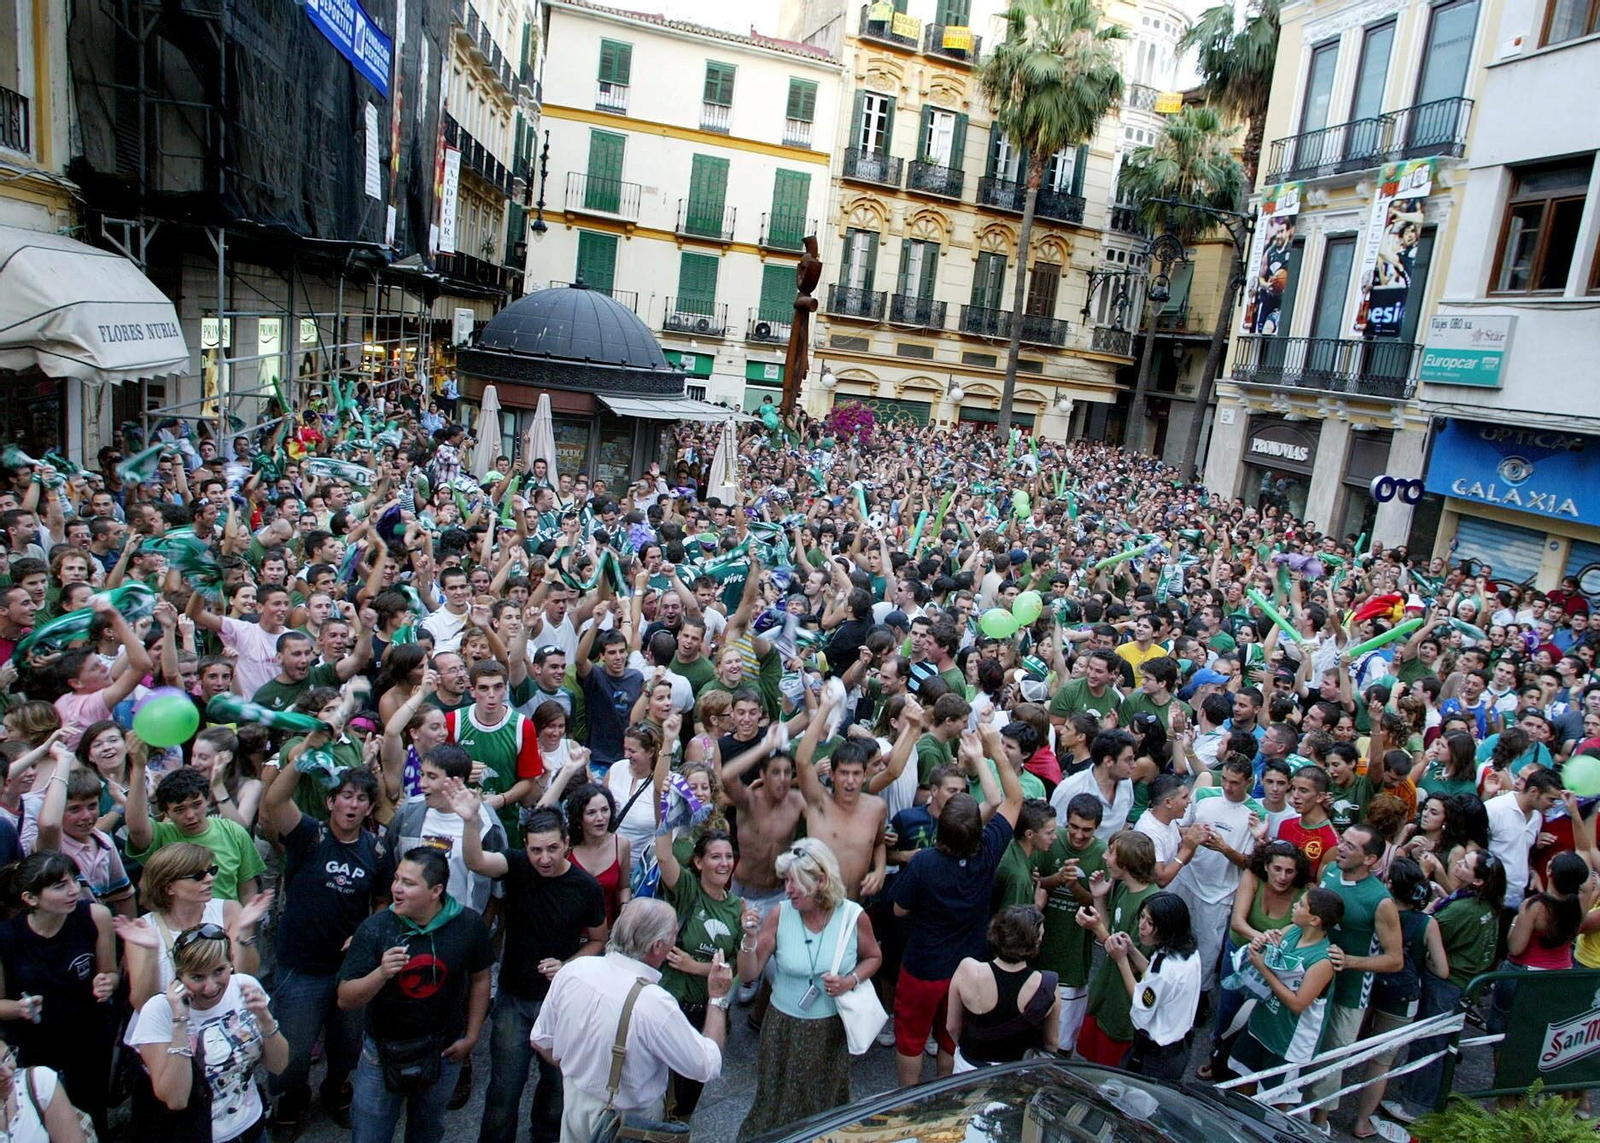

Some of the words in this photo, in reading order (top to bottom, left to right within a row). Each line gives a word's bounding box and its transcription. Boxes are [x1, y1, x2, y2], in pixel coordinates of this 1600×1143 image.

[98, 322, 145, 343] FLORES
[147, 321, 179, 340] NURIA
[203, 324, 229, 339] PRIMR
[1423, 353, 1479, 371] Europcar
[1251, 438, 1309, 462] PRONOVIAS
[1451, 477, 1579, 518] GALAXIA
[325, 860, 366, 879] GAP
